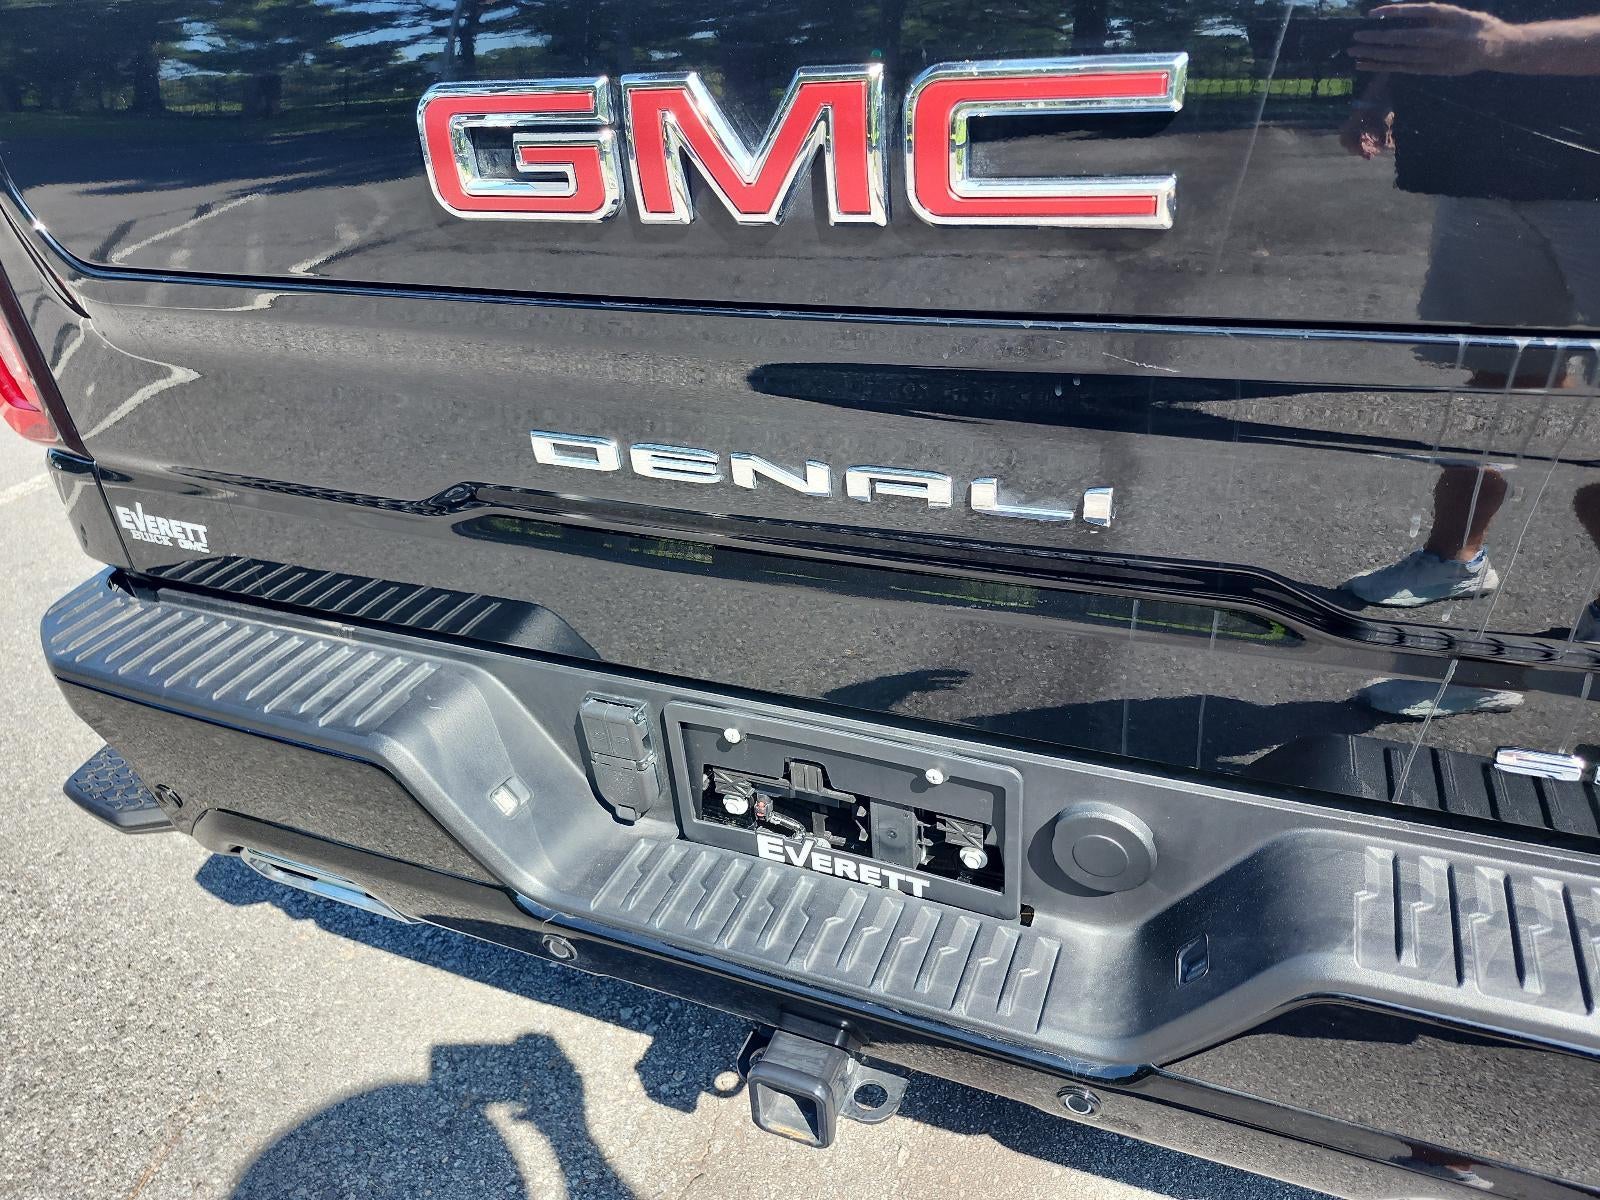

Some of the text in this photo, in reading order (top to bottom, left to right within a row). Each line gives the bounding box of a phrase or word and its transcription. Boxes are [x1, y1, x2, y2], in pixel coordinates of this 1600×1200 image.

[417, 52, 1188, 229] GMC
[530, 430, 1115, 527] DENALI
[115, 502, 208, 543] EVERETT
[130, 529, 210, 553] BUICK GMC
[757, 833, 930, 897] EVERETT
